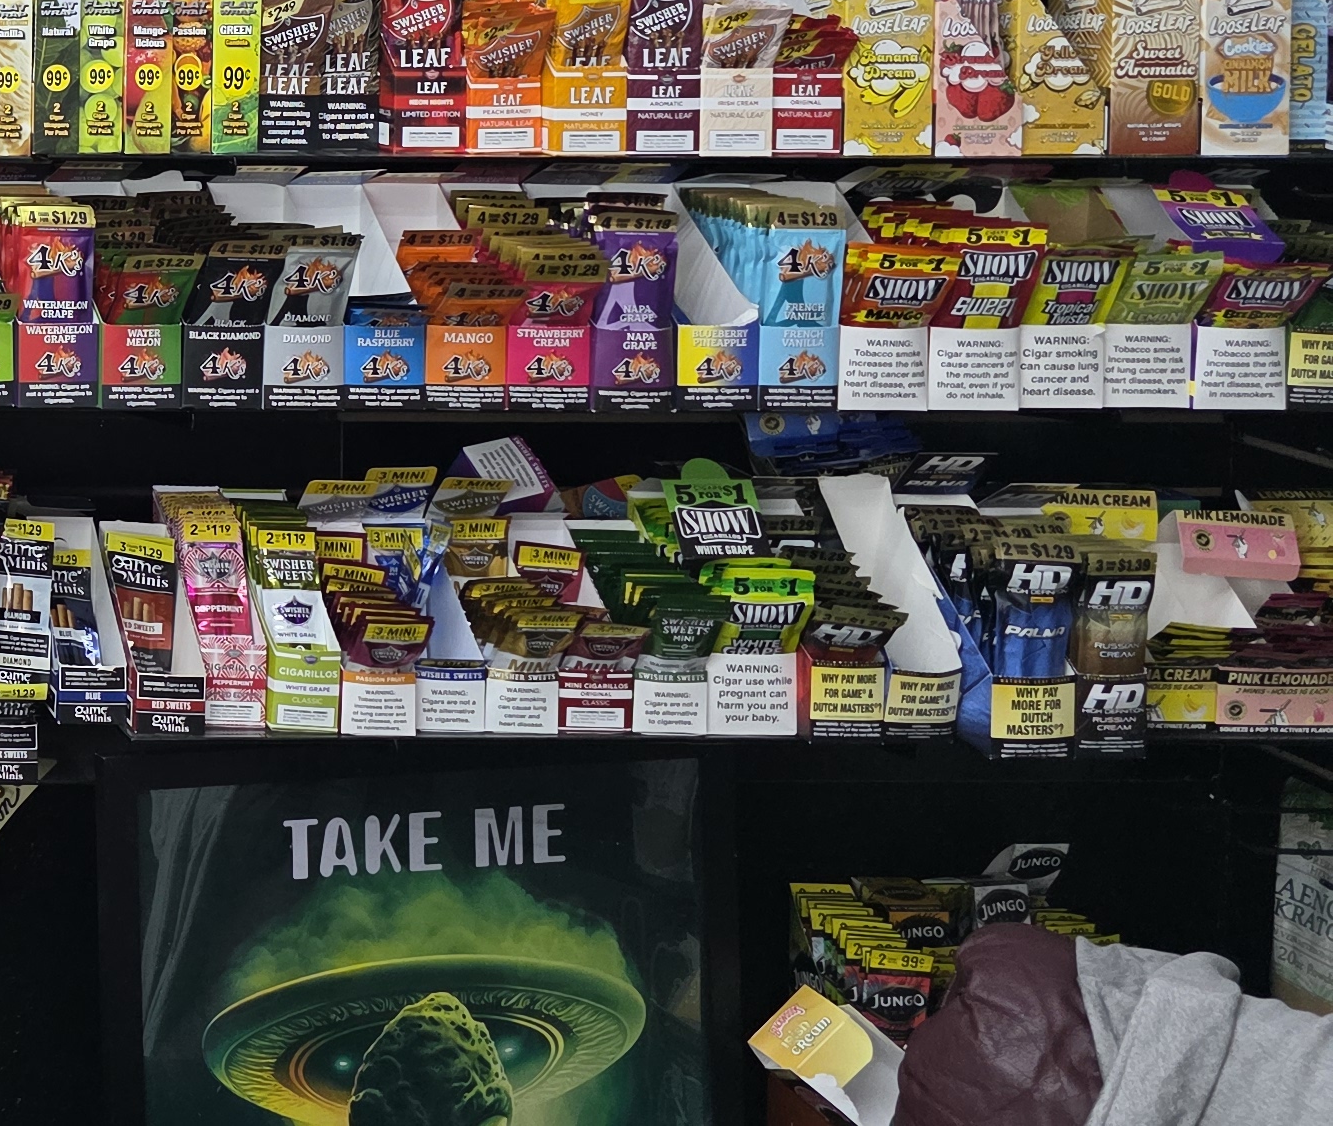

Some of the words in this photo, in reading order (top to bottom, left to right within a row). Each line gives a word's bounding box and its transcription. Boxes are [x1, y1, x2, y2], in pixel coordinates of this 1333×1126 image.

[219, 25, 253, 36] GREEN
[861, 49, 918, 65] Banana
[1134, 45, 1181, 60] Sweet
[1118, 60, 1195, 78] Aromatic
[1294, 24, 1315, 103] GELATO
[222, 66, 251, 88] 99¢
[651, 84, 683, 98] LEAF
[1152, 84, 1190, 100] GOLD
[961, 250, 1037, 277] SHOW
[26, 325, 92, 335] WATERMELON
[444, 332, 493, 343] MANGO
[1034, 335, 1089, 345] WARNING:
[1023, 349, 1050, 361] Cigar
[1054, 349, 1098, 360] smoking
[1184, 510, 1213, 521] PINK
[1216, 513, 1284, 525] LEMONADE
[126, 574, 168, 588] Minis
[1008, 563, 1072, 589] HD
[726, 663, 782, 674] WARNING:
[283, 811, 442, 879] TAKE
[474, 803, 566, 868] ME
[872, 992, 925, 1008] JUNGO
